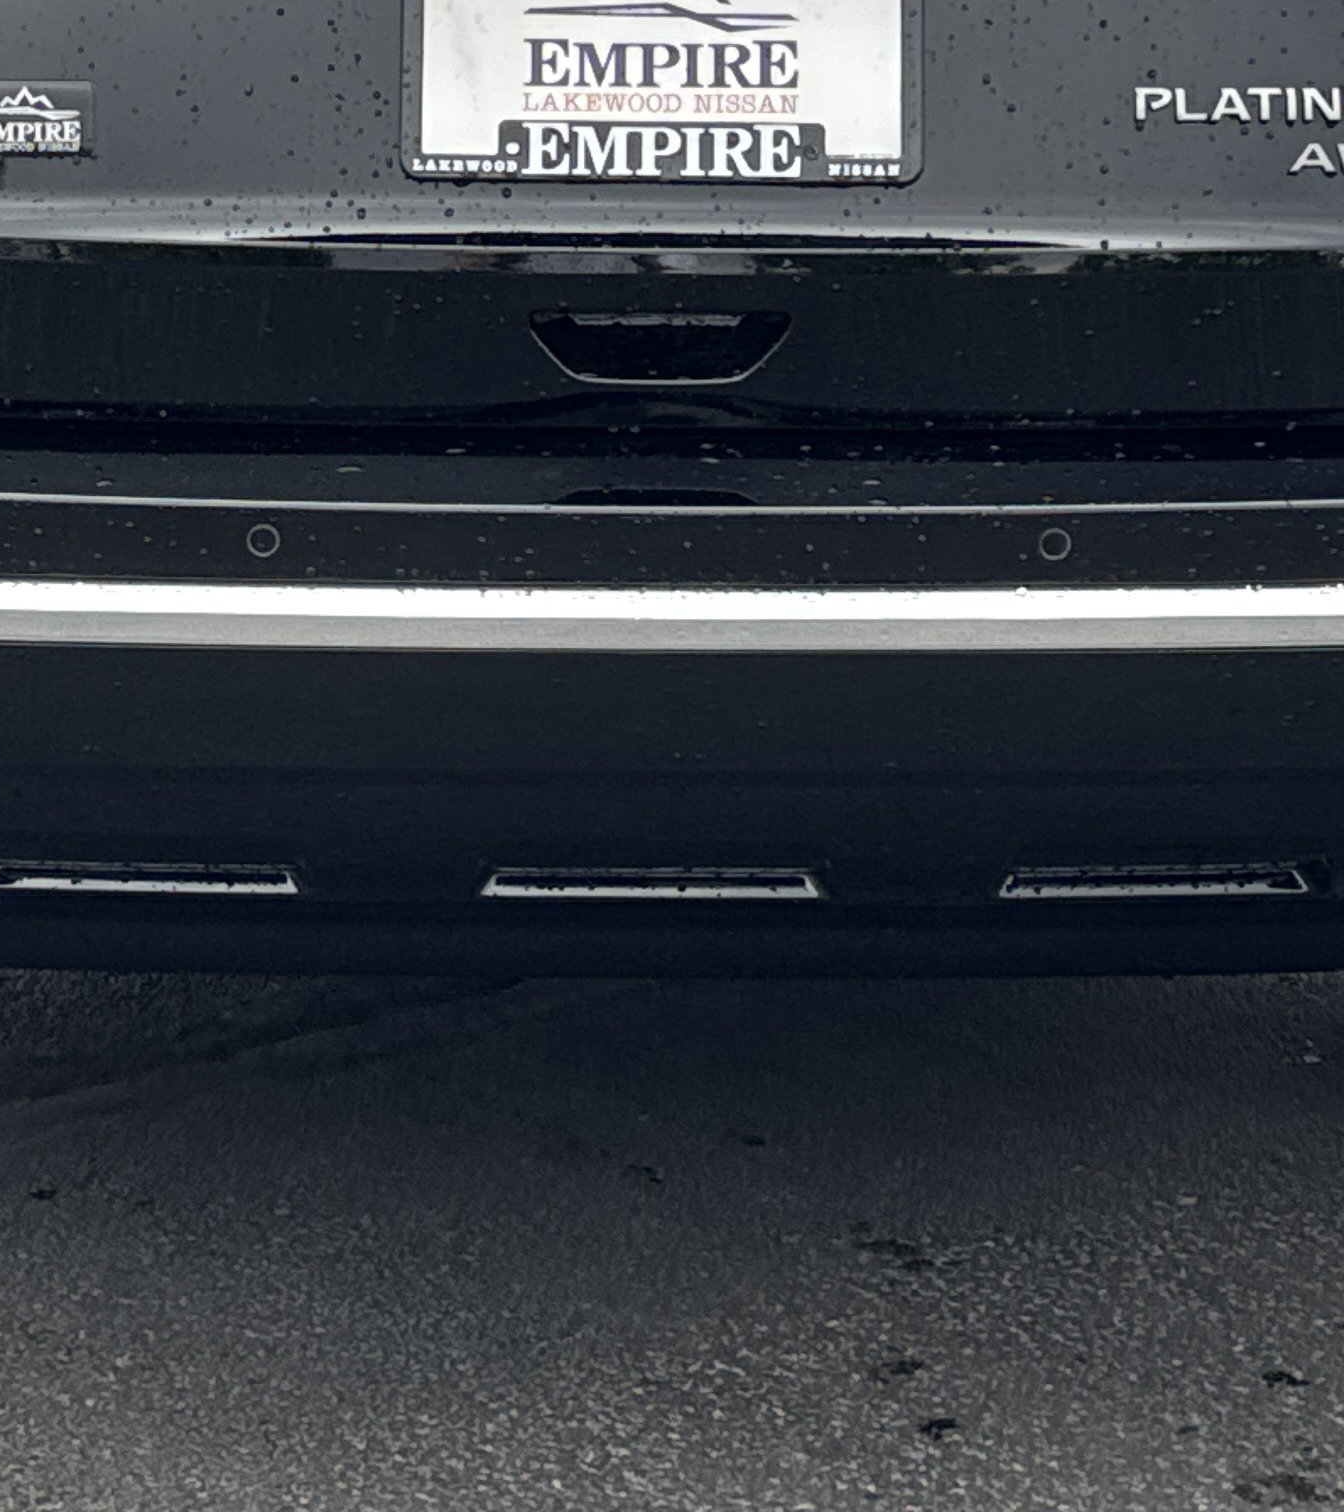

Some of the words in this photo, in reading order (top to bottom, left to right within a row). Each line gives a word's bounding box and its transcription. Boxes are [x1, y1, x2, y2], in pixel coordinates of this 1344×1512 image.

[523, 37, 800, 89] EMPIRE
[521, 92, 683, 114] LAKEWOOD
[693, 93, 799, 115] NISSAN
[521, 121, 802, 178] EMPIRE
[411, 157, 519, 174] LAKEWOOD
[828, 162, 902, 177] NISSAN
